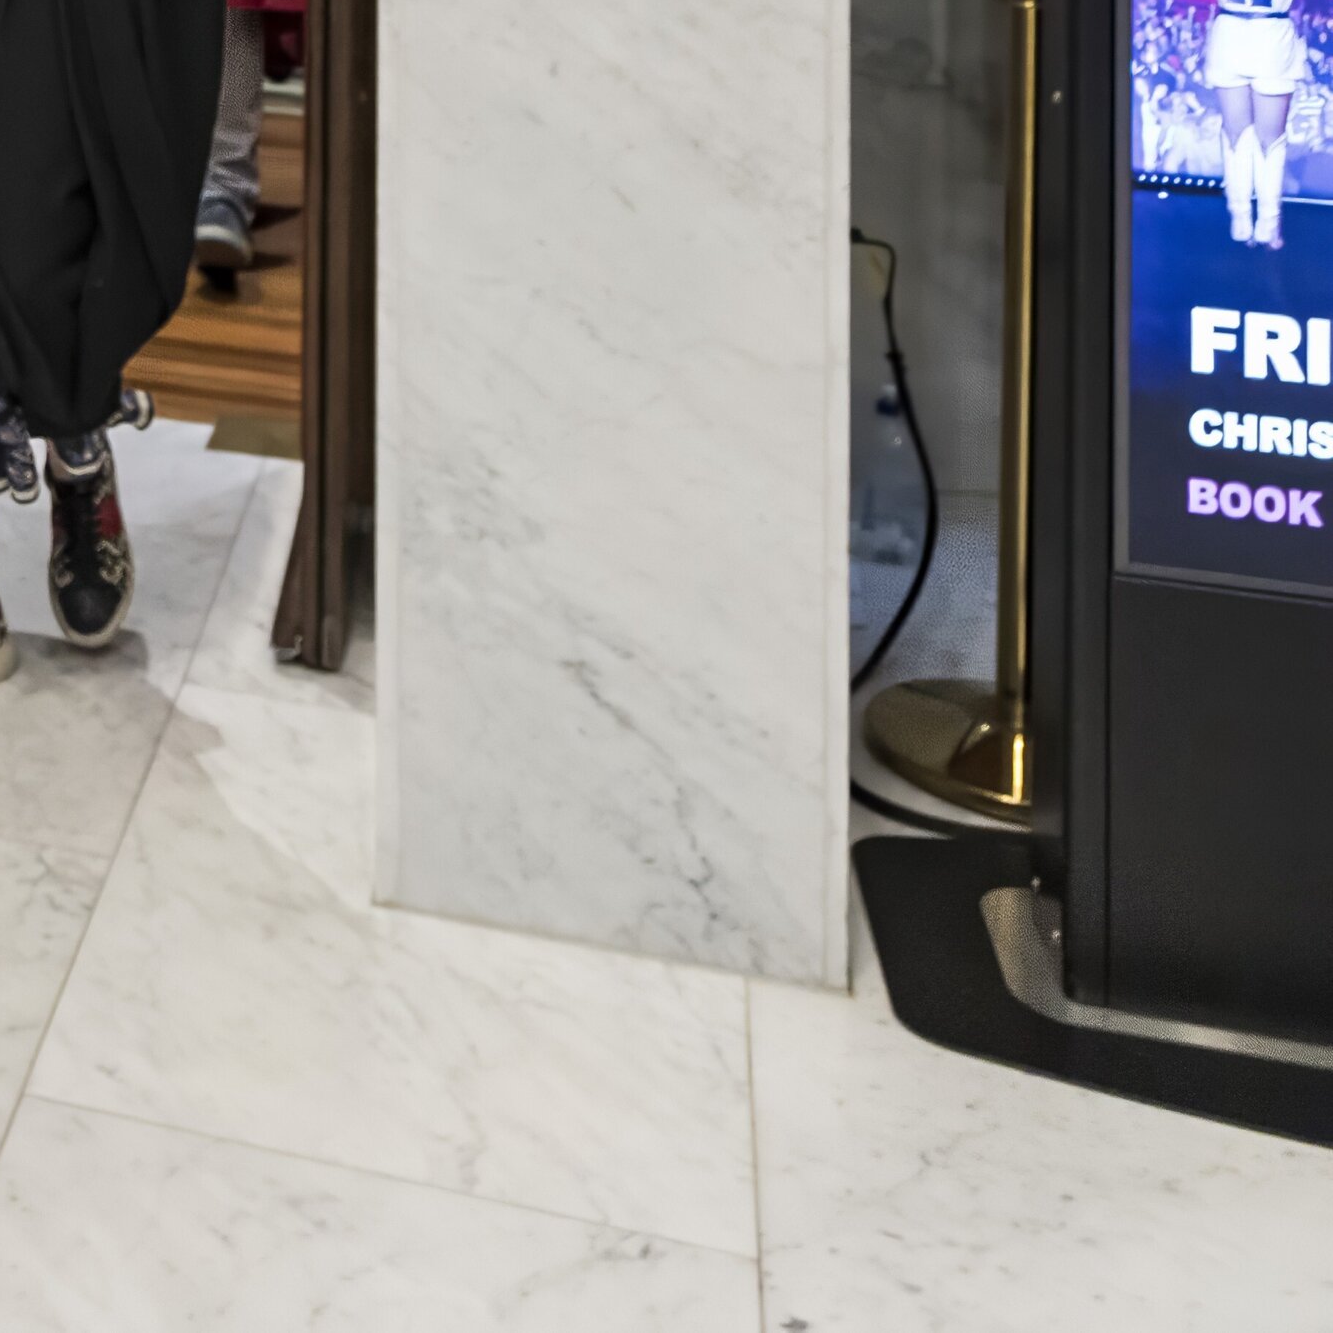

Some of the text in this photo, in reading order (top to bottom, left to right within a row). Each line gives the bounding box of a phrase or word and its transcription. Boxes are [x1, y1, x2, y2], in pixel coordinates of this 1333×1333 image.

[1190, 305, 1331, 386] FRI
[1188, 408, 1333, 460] CHRIS
[1187, 476, 1324, 528] BOOK
